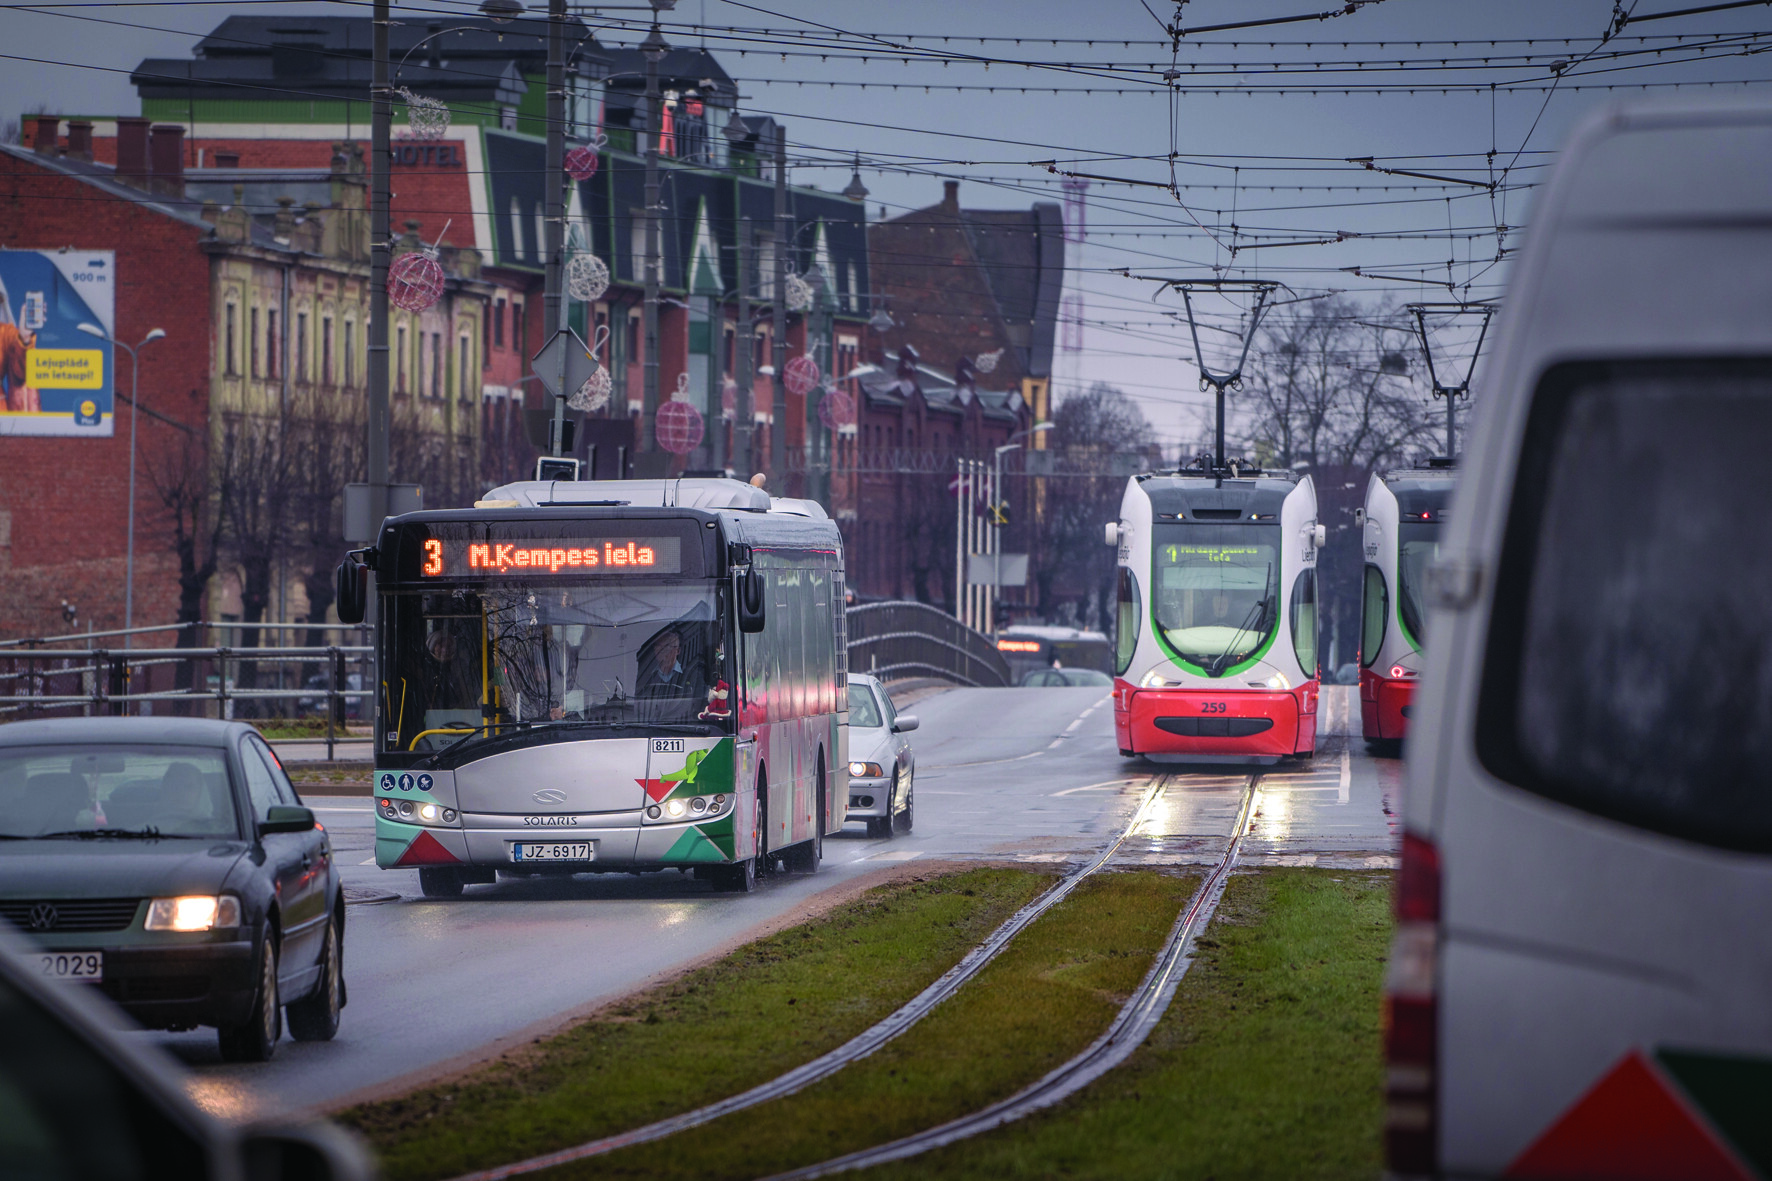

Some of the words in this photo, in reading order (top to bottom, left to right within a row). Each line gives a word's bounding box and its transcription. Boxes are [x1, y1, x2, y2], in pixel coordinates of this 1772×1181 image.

[73, 273, 94, 282] 900
[36, 372, 49, 380] un
[52, 371, 94, 382] ietaupi!
[423, 538, 443, 575] 3
[604, 541, 654, 565] iela
[1166, 544, 1177, 562] 1
[1208, 553, 1231, 562] iela
[1201, 702, 1227, 713] 259
[655, 740, 680, 750] 8211
[523, 816, 578, 826] SOLARIS
[525, 845, 587, 858] JZ-6917
[41, 955, 98, 976] 2029
